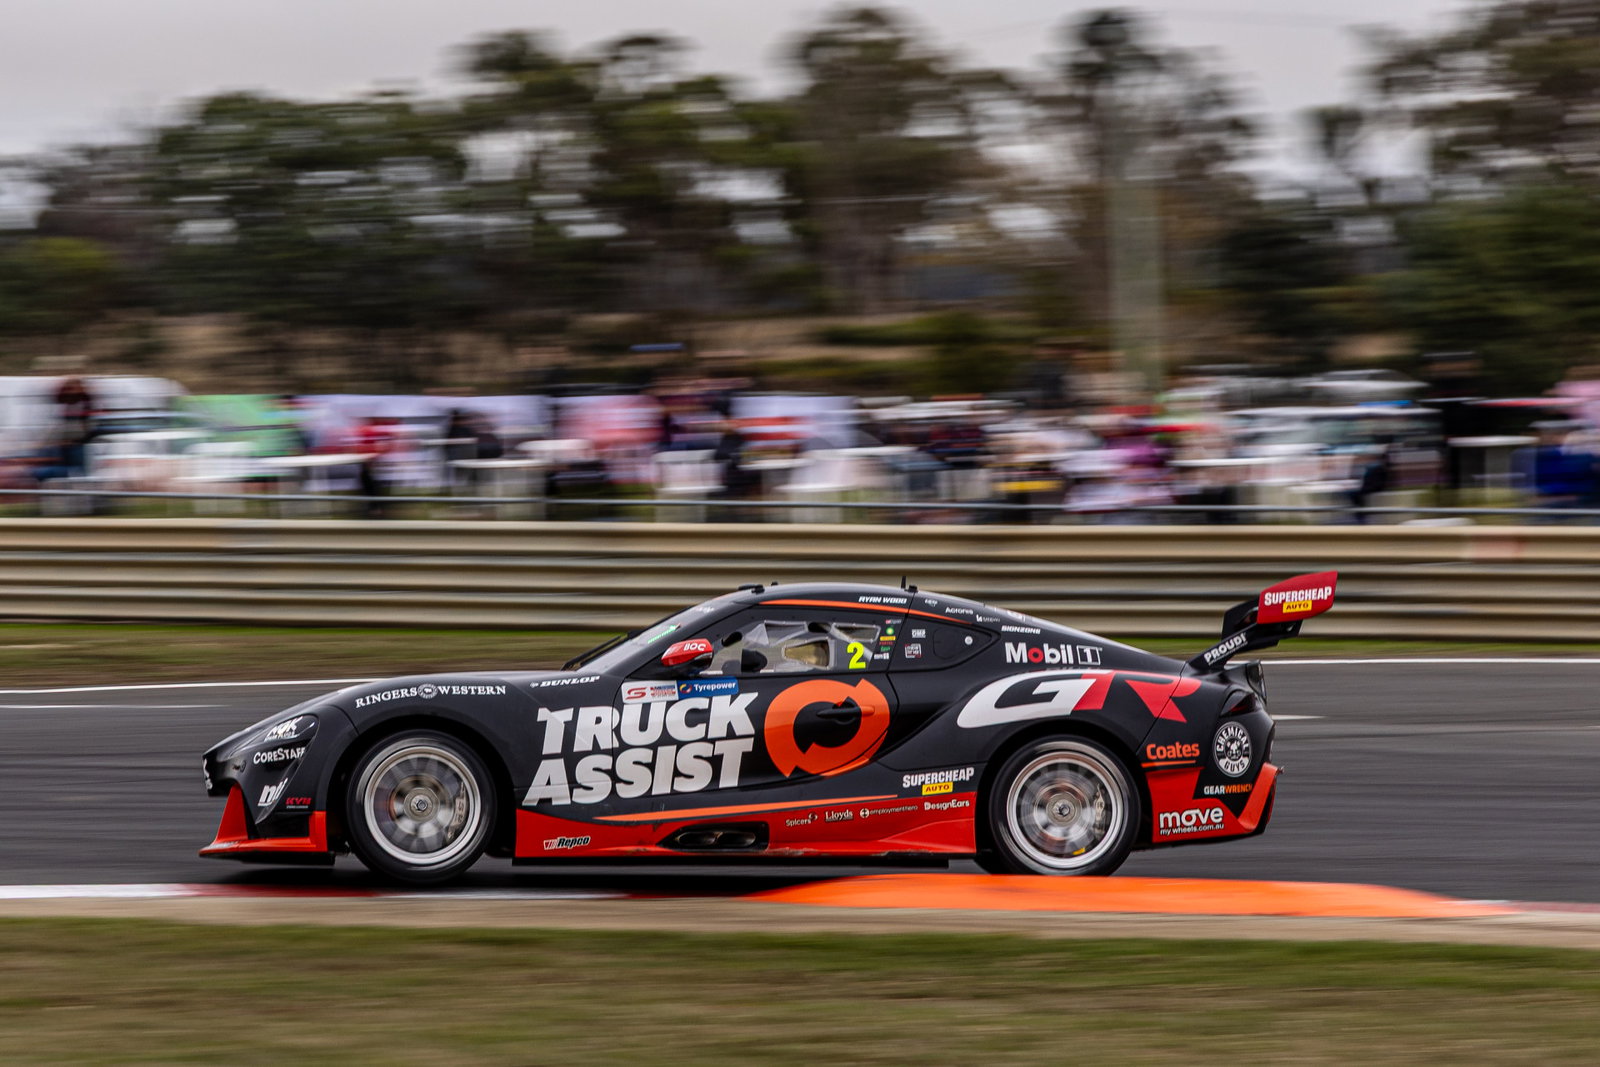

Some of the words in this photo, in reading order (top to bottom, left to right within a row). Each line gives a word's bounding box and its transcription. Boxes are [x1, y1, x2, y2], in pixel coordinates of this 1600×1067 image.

[1264, 586, 1332, 606] SUPERCHEAP
[1285, 602, 1309, 610] AUTO
[683, 643, 707, 651] BOC
[846, 641, 867, 669] 2
[1005, 642, 1074, 664] Mobil
[540, 676, 600, 688] DUNLOP
[694, 682, 737, 693] Tyrepower
[355, 686, 418, 708] RINGERS
[438, 684, 507, 696] WESTERN
[537, 692, 759, 755] TRUCK
[1216, 725, 1250, 752] CHEMICAL
[1146, 741, 1201, 759] Coates
[522, 737, 755, 806] ASSIST
[1224, 761, 1246, 772] GUYS
[902, 767, 975, 788] SUPERCHEAP
[925, 784, 950, 793] AUTO
[825, 809, 854, 821] Lloyds
[1159, 807, 1224, 829] move
[1160, 828, 1172, 836] my
[1172, 823, 1225, 834] wheels.com.au
[556, 835, 591, 849] Repco
